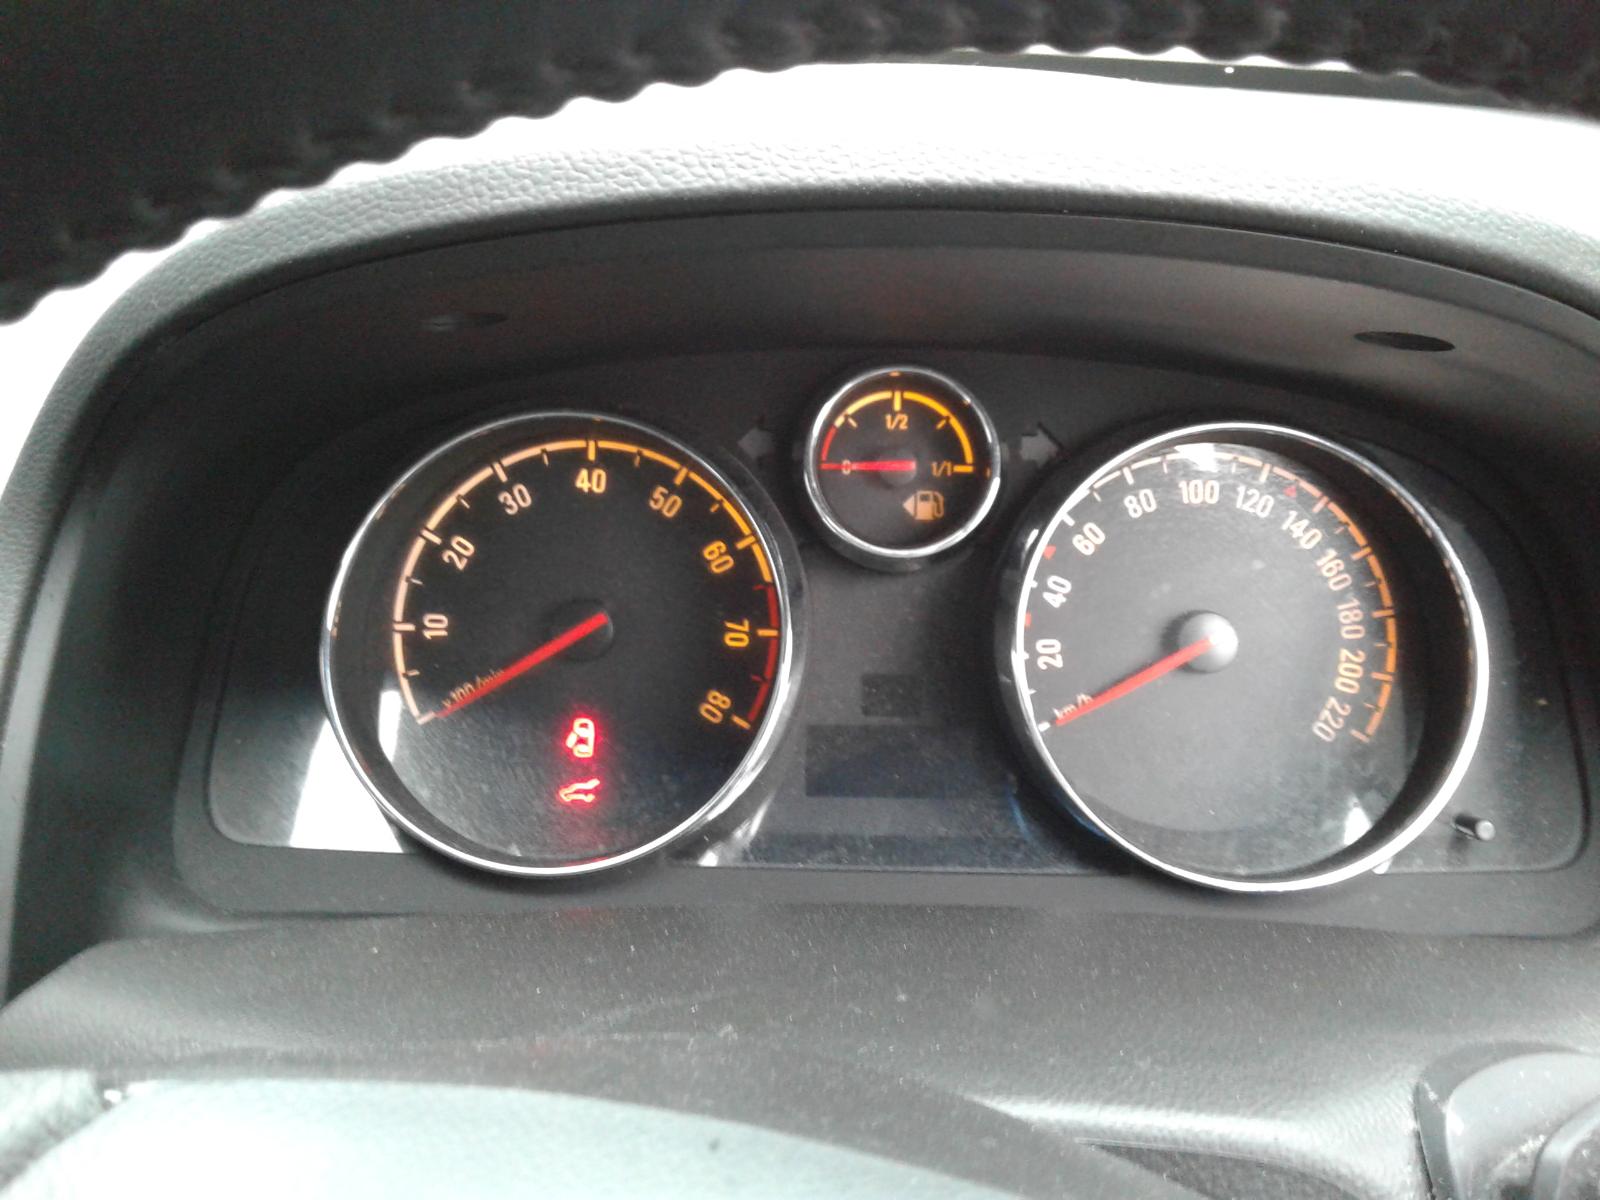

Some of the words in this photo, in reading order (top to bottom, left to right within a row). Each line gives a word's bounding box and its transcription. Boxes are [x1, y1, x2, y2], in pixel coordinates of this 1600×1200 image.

[885, 414, 909, 430] 1/2
[575, 468, 607, 494] 40
[931, 461, 951, 477] 1/1
[498, 483, 532, 515] 30
[650, 486, 682, 518] 50
[1123, 488, 1158, 519] 80
[1178, 479, 1220, 505] 100
[1235, 484, 1275, 518] 120
[1072, 522, 1106, 556] 60
[1280, 510, 1323, 550] 140
[442, 535, 475, 571] 20
[702, 540, 735, 575] 60
[1315, 548, 1352, 591] 160
[1042, 575, 1072, 608] 40
[422, 613, 449, 640] 10
[723, 618, 749, 648] 70
[1336, 597, 1366, 640] 180
[1035, 638, 1064, 671] 20
[1334, 648, 1367, 694] 200
[699, 689, 732, 724] 80
[1311, 696, 1352, 743] 220
